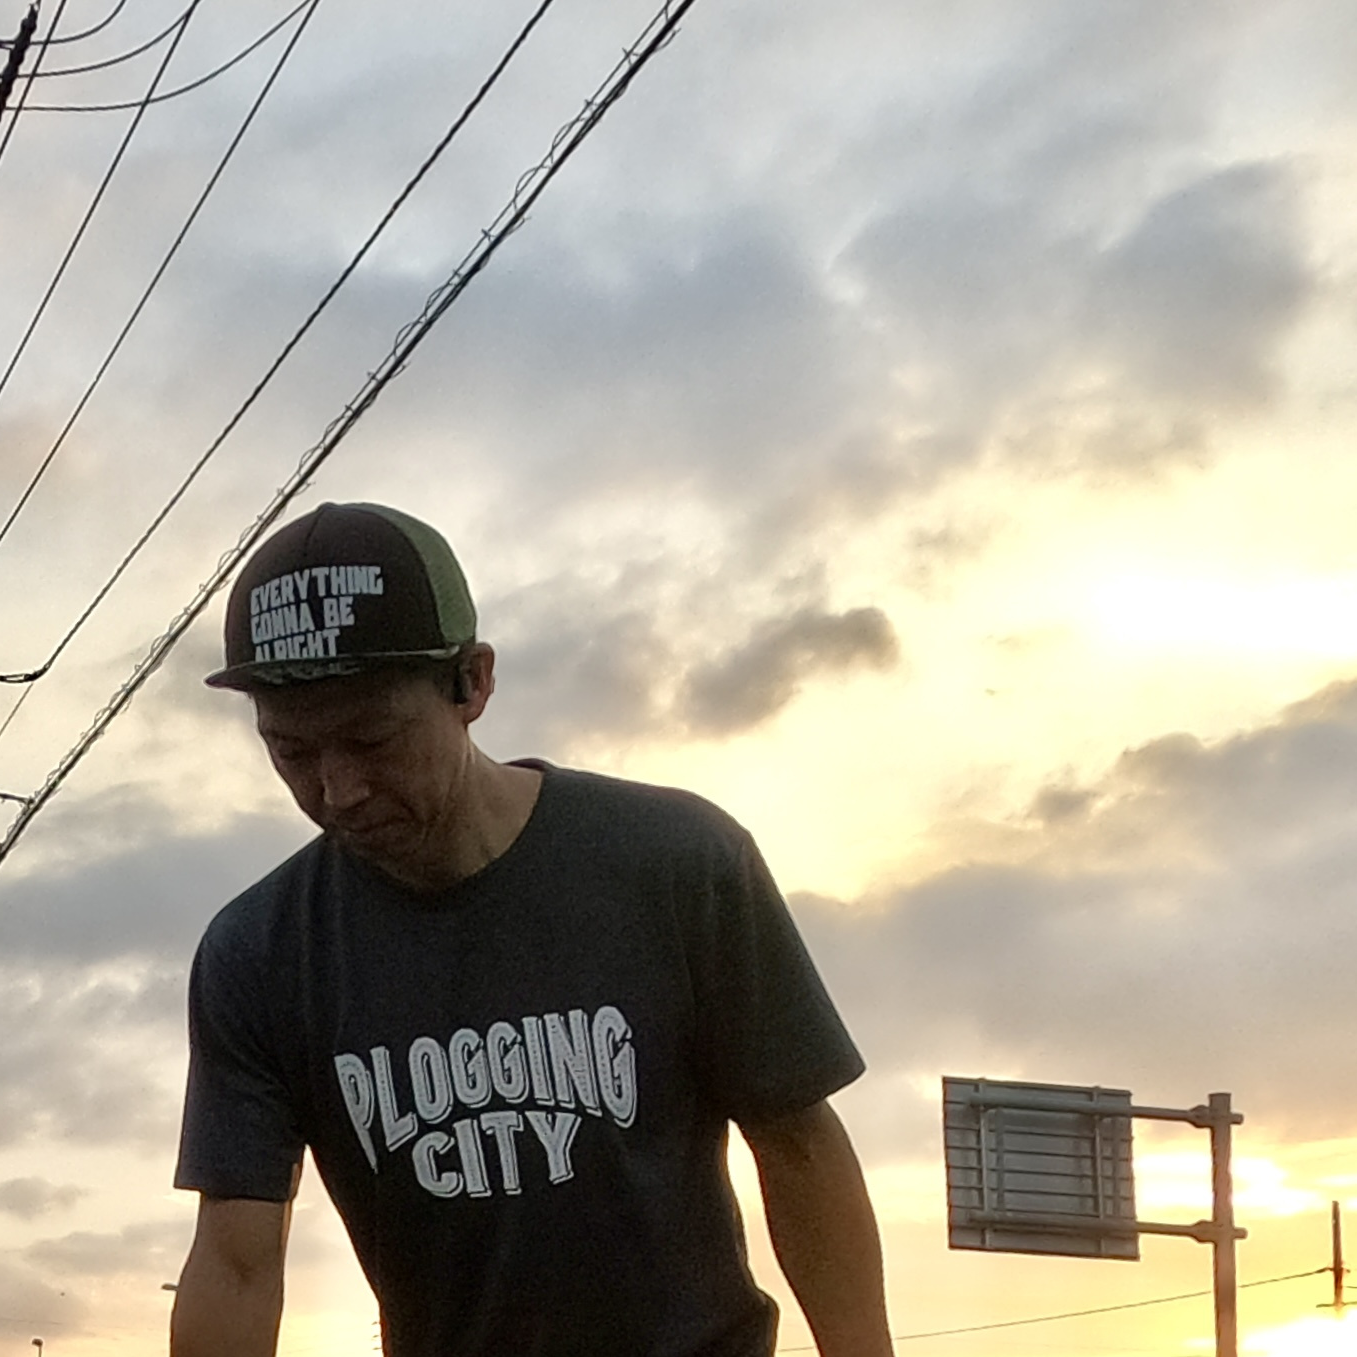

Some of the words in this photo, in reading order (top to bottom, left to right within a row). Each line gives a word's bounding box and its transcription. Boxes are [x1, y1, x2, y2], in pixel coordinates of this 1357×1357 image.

[250, 565, 384, 615] EVERYTHING
[251, 602, 315, 645] GONNA
[323, 596, 355, 627] BE
[334, 1005, 637, 1174] PLOGGING
[412, 1111, 581, 1198] CITY
